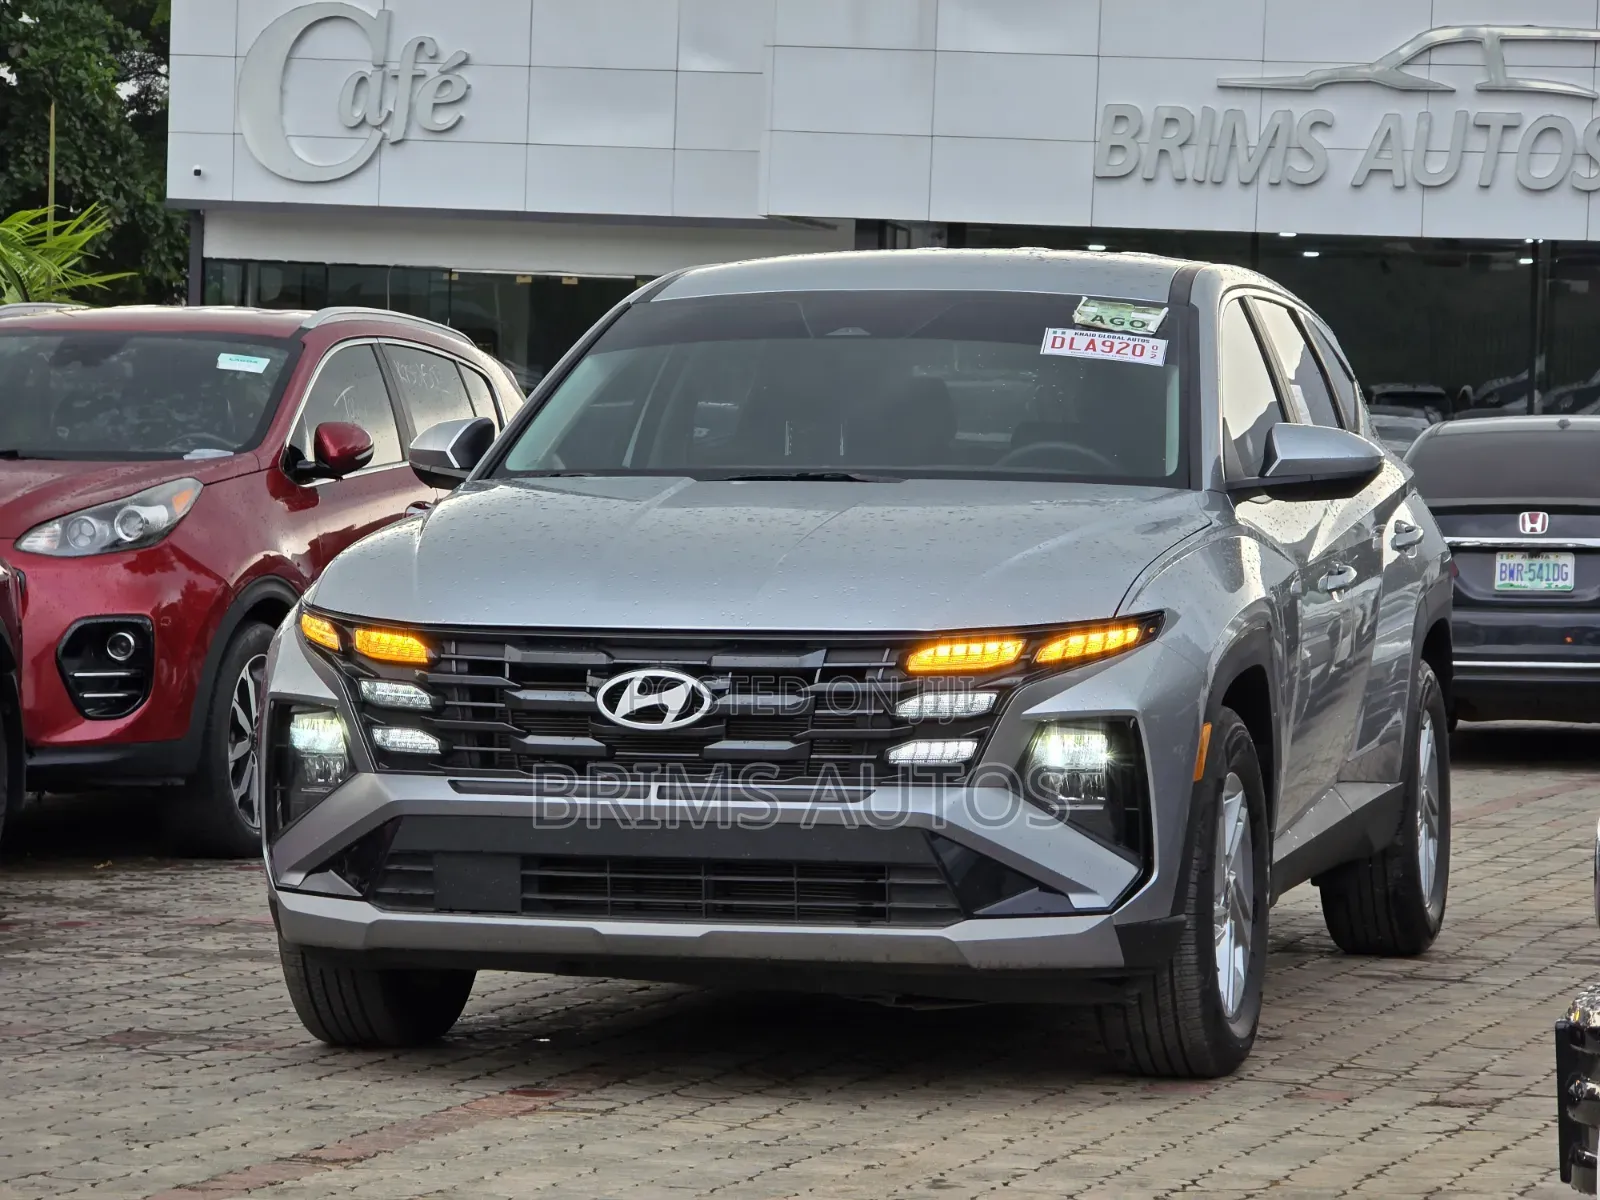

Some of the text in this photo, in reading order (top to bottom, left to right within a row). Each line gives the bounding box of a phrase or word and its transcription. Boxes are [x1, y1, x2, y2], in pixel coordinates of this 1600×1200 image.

[237, 1, 472, 183] Café
[1095, 104, 1600, 191] BRIMS AUTOS
[1050, 335, 1146, 358] DLA920
[1499, 562, 1569, 582] BWR-541DG
